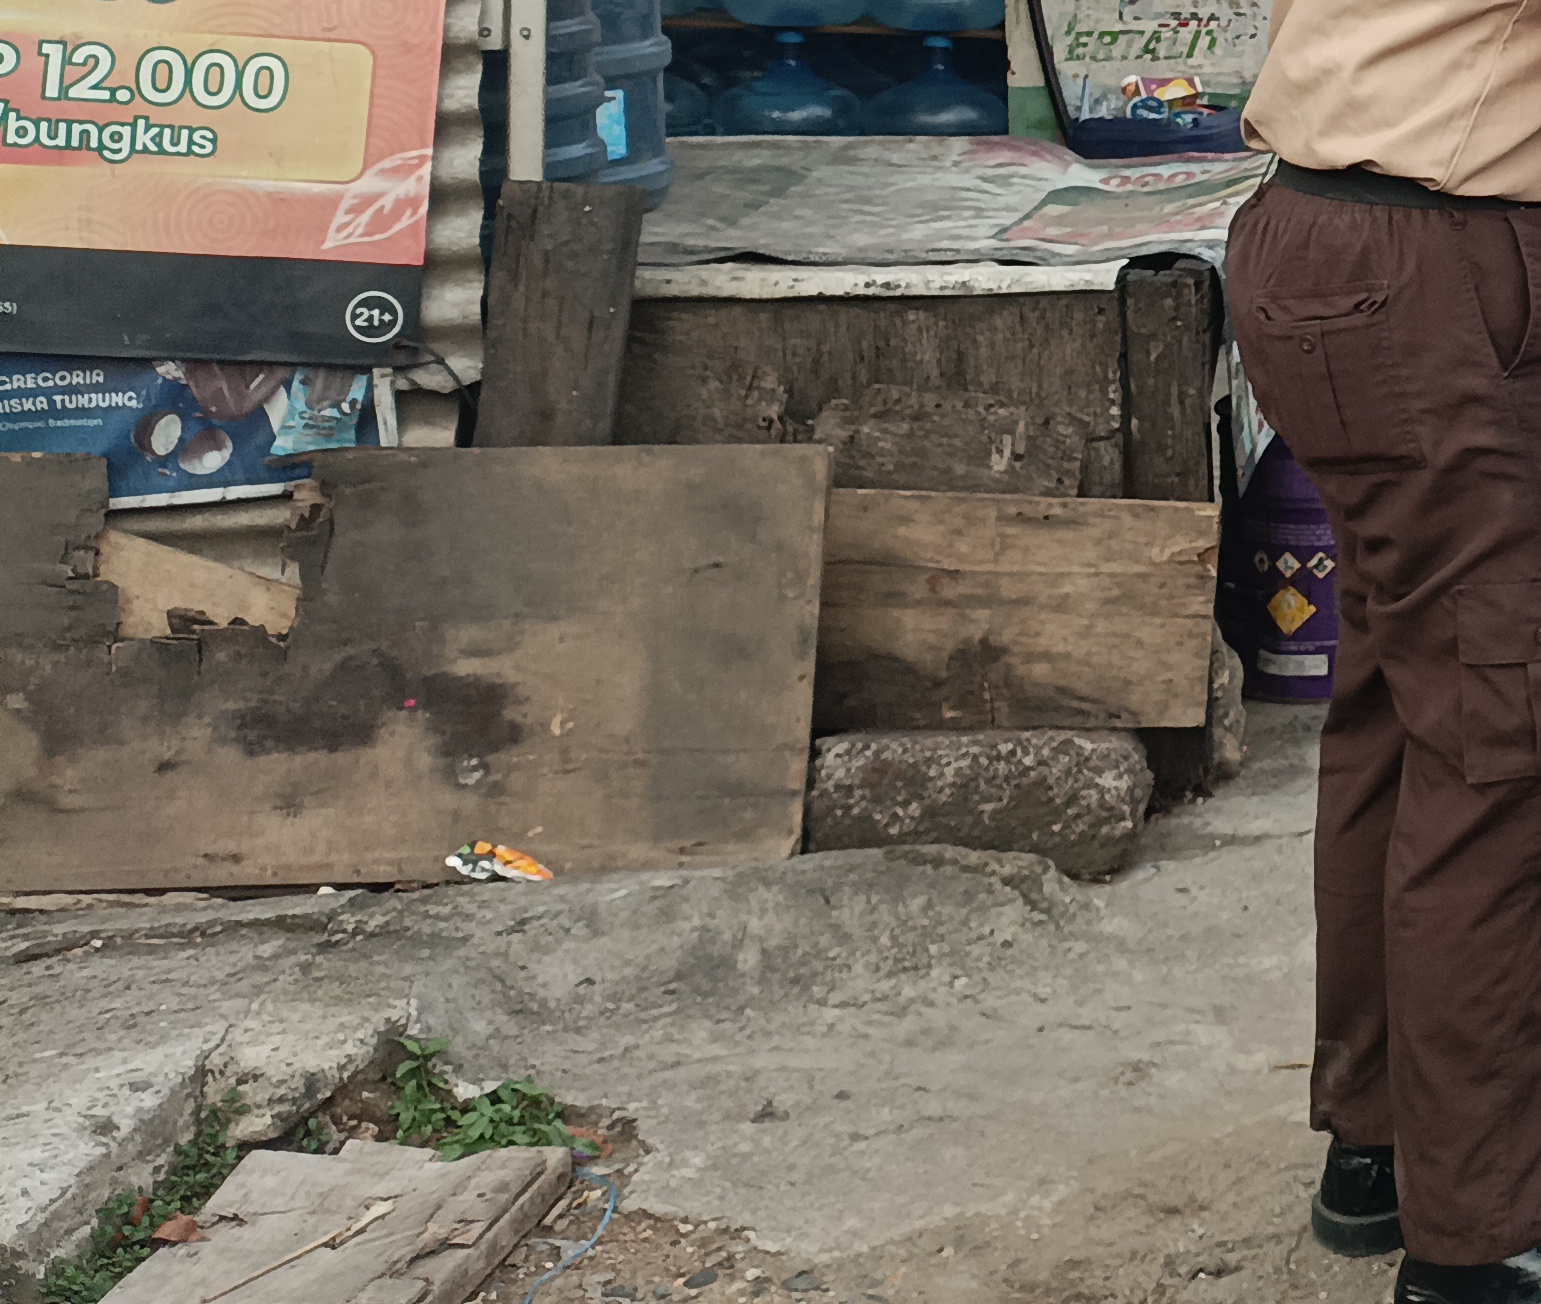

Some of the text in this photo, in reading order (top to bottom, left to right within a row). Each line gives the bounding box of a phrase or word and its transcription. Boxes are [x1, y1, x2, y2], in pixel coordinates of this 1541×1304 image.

[37, 40, 289, 113] 12.000
[354, 307, 393, 327] 21+
[0, 368, 105, 391] GREGORIA
[0, 395, 49, 414] ISKA
